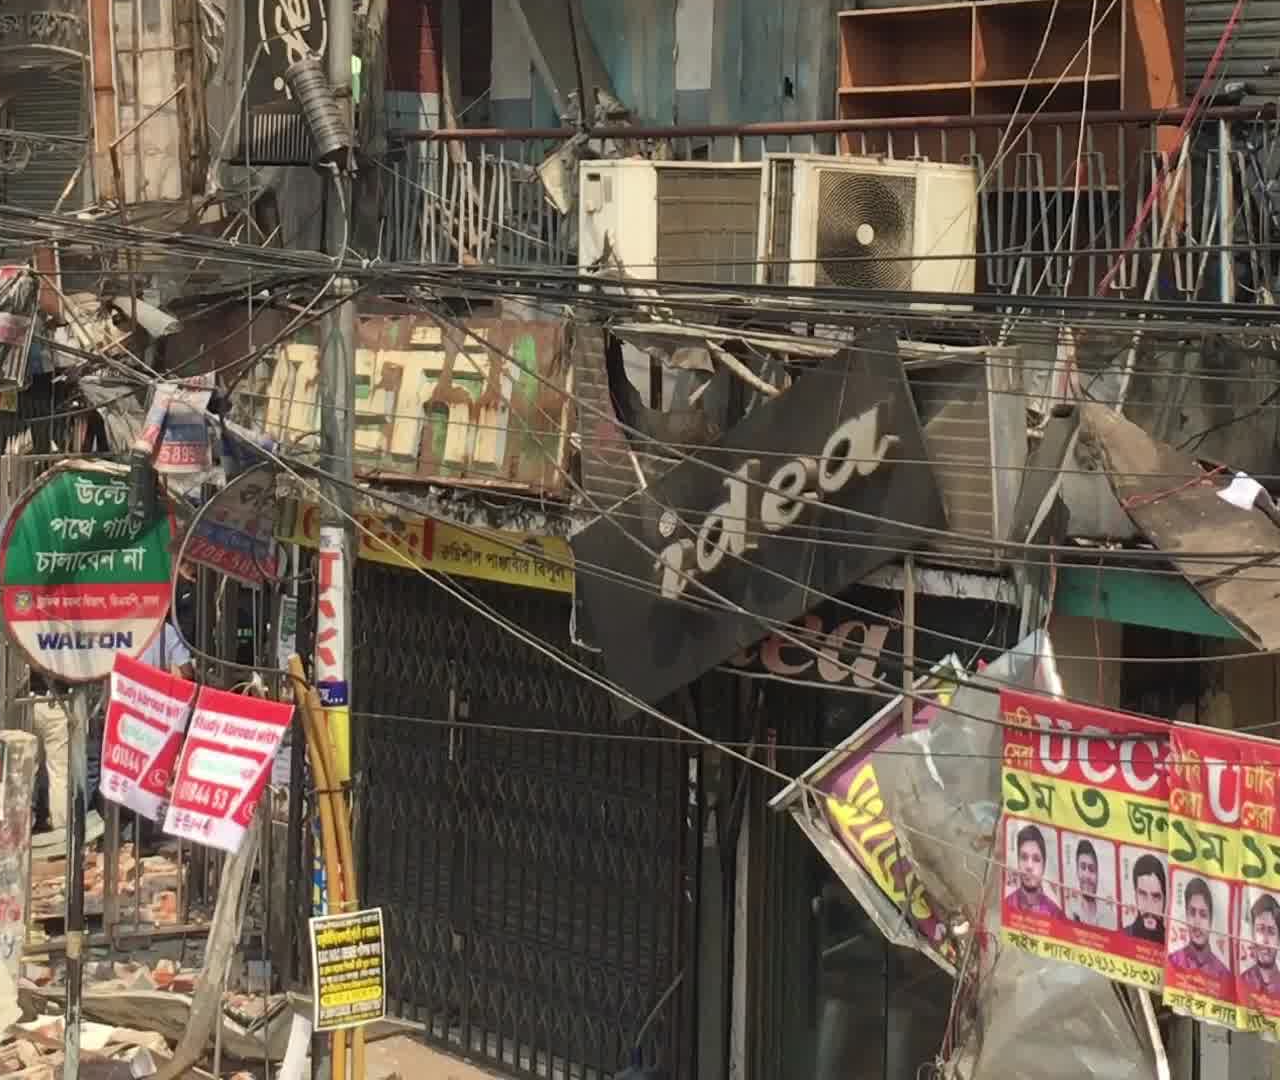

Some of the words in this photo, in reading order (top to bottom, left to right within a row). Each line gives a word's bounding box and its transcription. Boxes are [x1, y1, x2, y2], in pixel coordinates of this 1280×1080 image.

[50, 516, 96, 540] পথে
[35, 549, 120, 573] চালাবেন
[121, 545, 148, 571] না
[36, 631, 133, 650] WALTON
[193, 714, 221, 737] Study
[222, 722, 254, 740] Abroad
[1034, 713, 1160, 792] UCC
[1005, 772, 1056, 819] ১ম
[1070, 787, 1111, 829] ৩
[1171, 820, 1229, 873] ১ম
